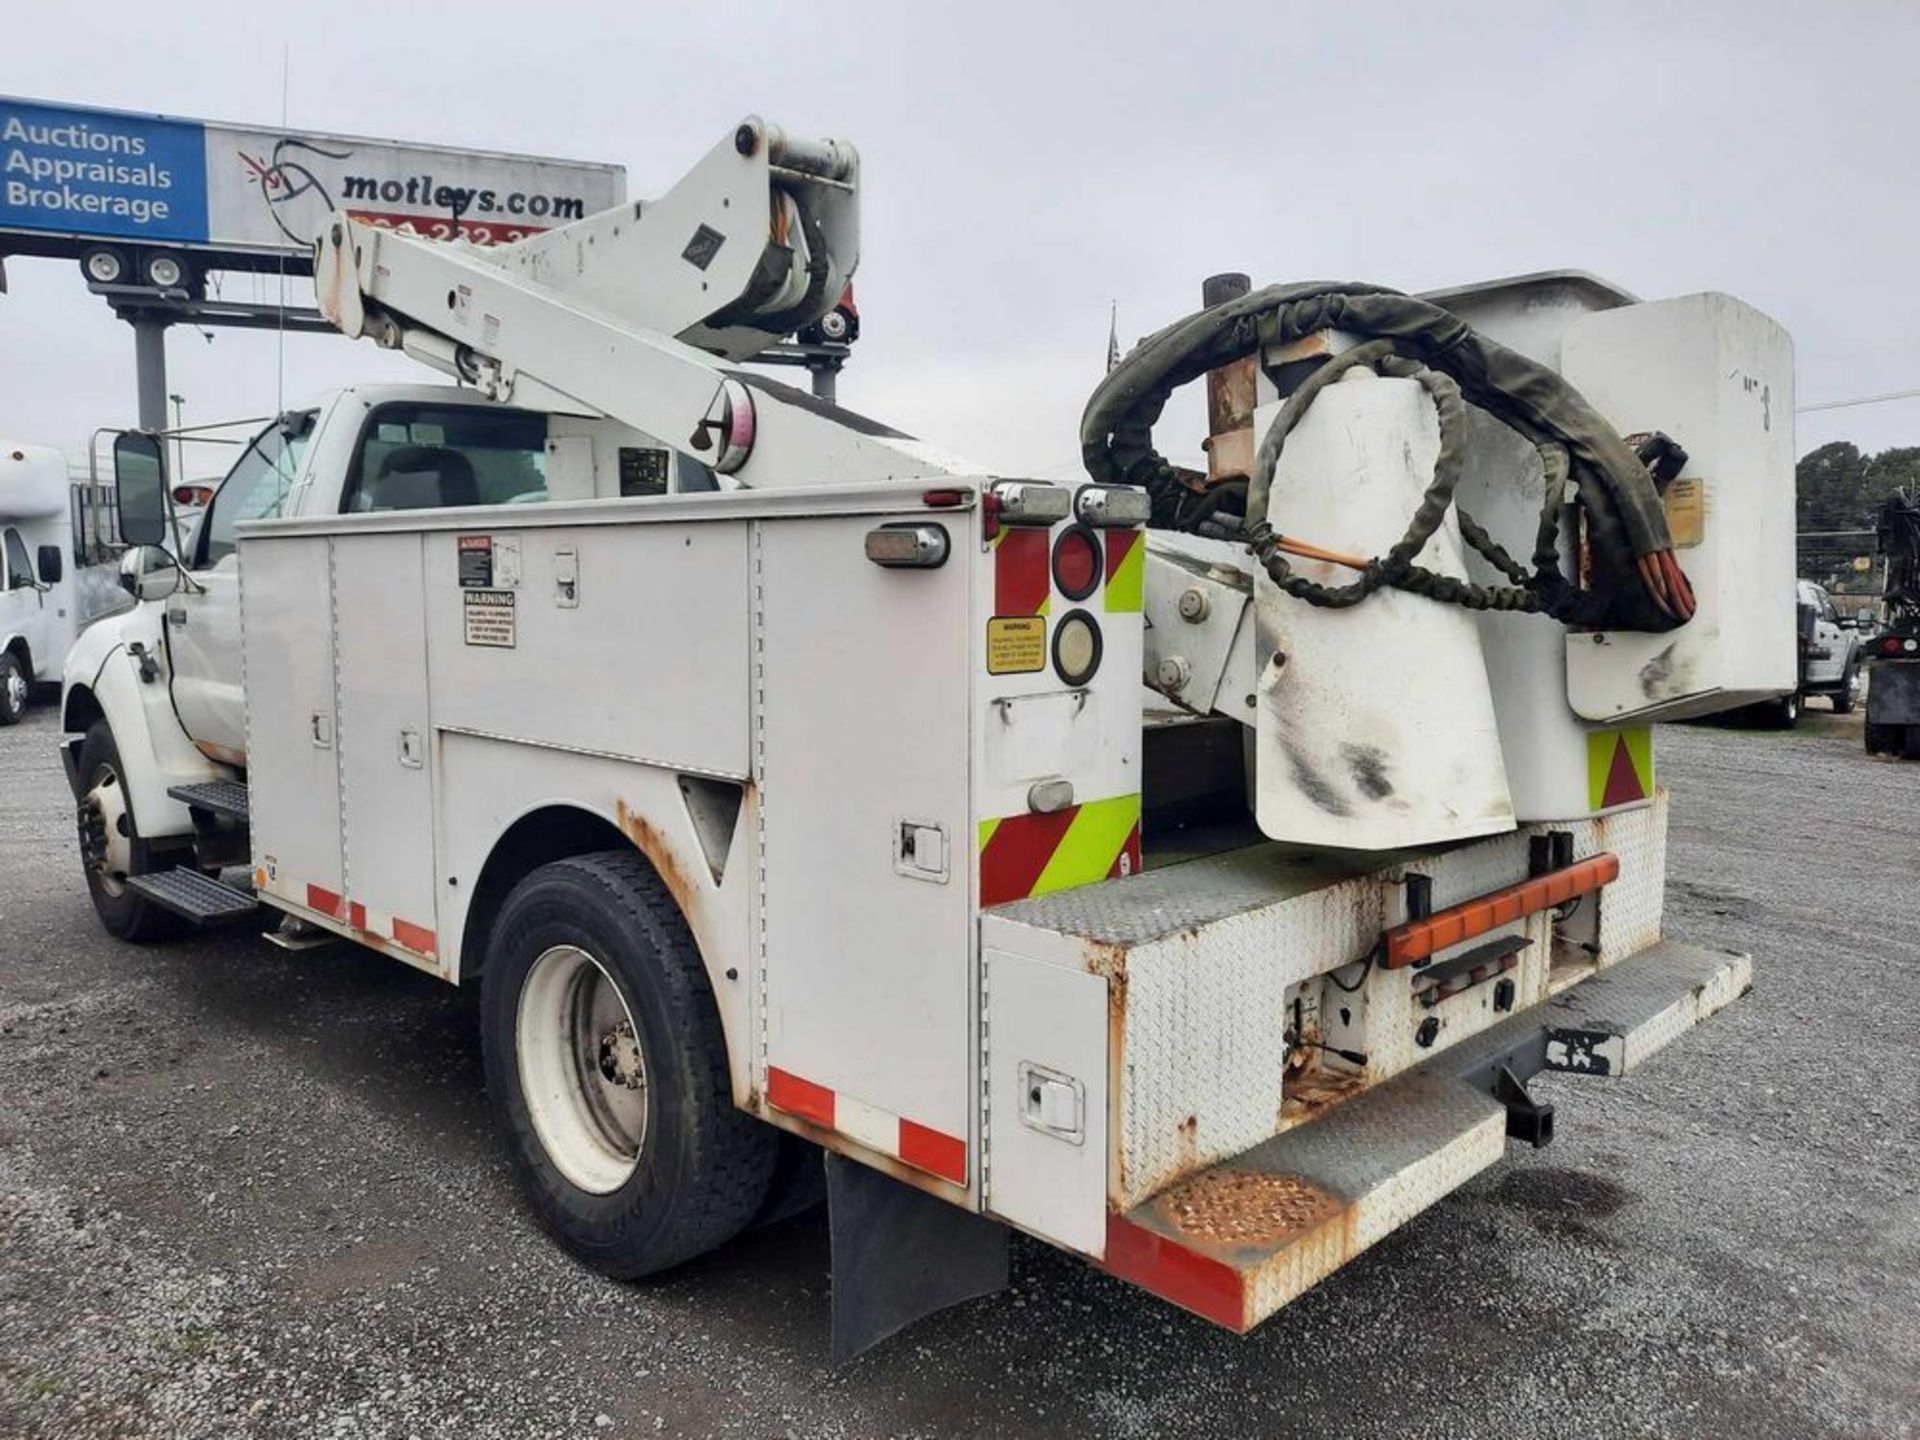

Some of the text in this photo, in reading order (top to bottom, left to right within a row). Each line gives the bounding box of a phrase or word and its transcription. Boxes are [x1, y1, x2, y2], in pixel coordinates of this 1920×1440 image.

[3, 117, 147, 156] Auctions
[5, 149, 172, 189] Appraisals
[6, 181, 170, 224] Brokerage
[341, 174, 585, 220] motleys.com
[466, 592, 513, 606] WARNING
